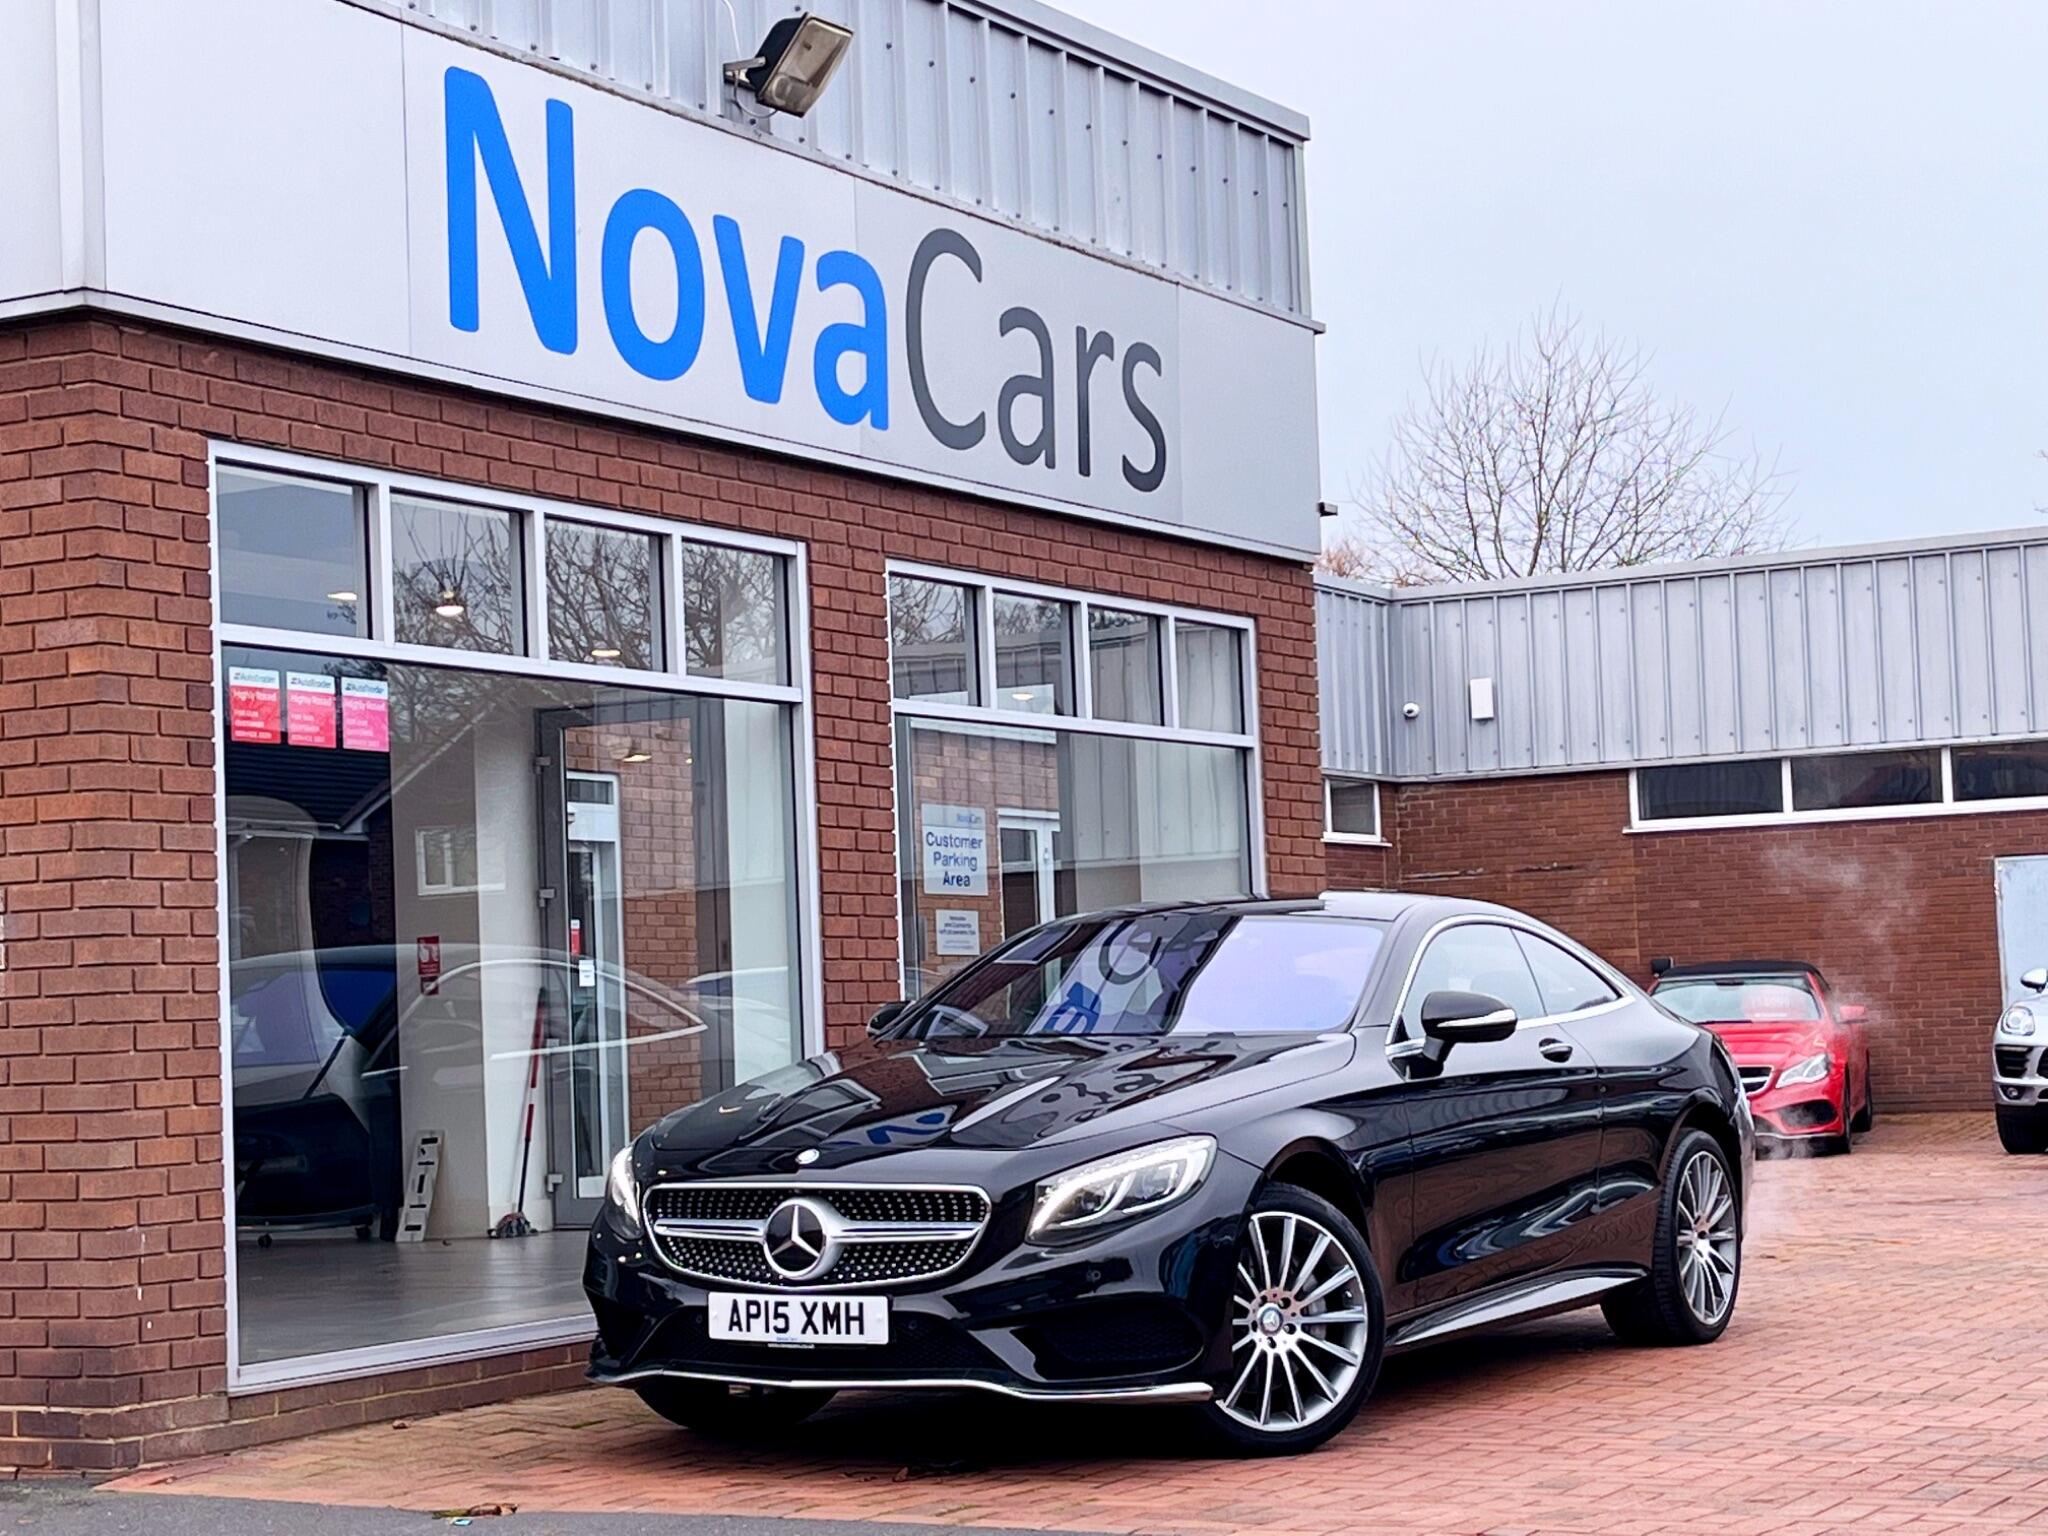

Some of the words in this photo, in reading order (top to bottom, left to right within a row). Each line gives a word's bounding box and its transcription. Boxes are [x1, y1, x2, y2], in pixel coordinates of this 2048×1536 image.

[926, 832, 983, 849] Customer
[933, 851, 978, 871] Parking
[943, 871, 971, 887] Area
[728, 1299, 790, 1334] AP15
[800, 1301, 865, 1335] XMH
